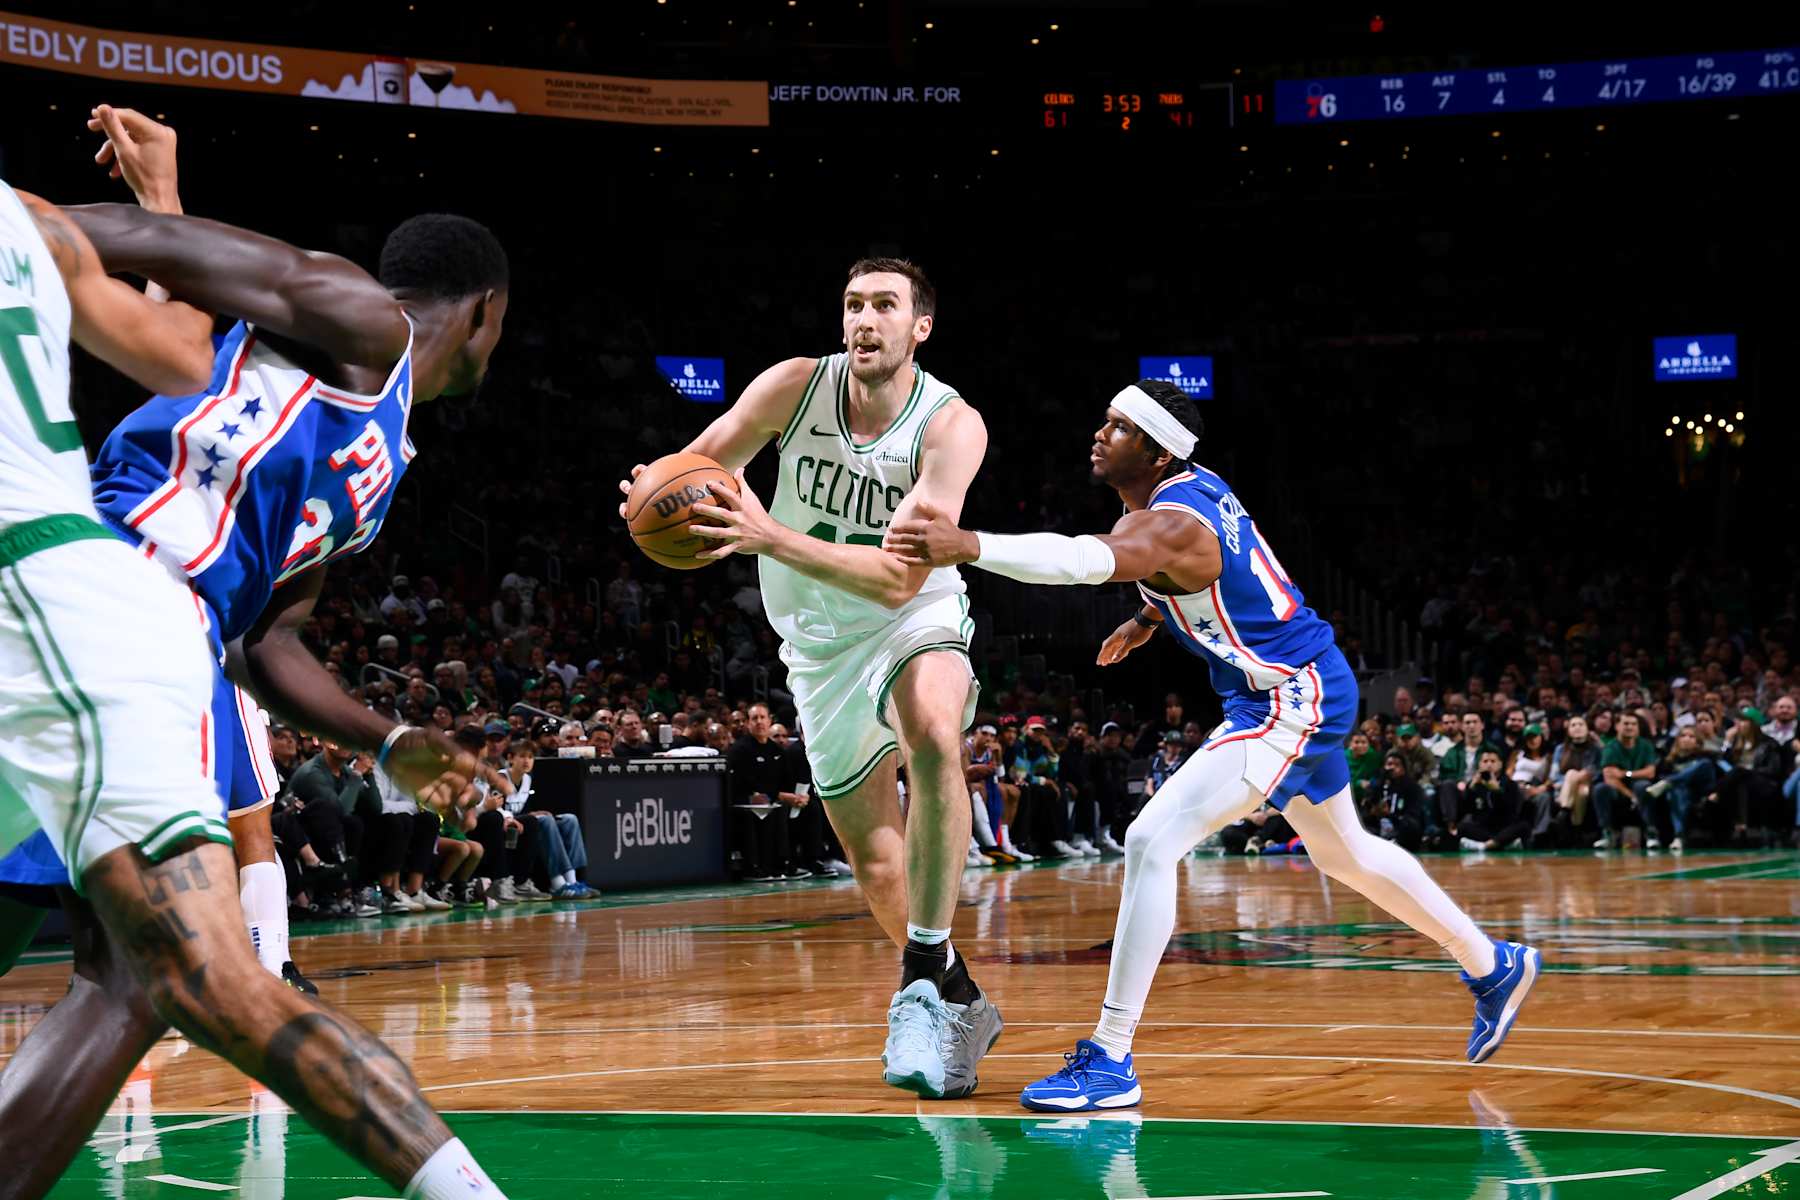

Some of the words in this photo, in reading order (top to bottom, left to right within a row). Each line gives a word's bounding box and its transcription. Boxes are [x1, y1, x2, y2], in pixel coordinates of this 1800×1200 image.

[98, 39, 283, 84] DELICIOUS
[1432, 75, 1455, 87] AST
[1487, 72, 1507, 83] STL
[1538, 69, 1556, 80] TO
[1679, 72, 1736, 94] 16/39
[1381, 79, 1404, 90] REB
[1599, 79, 1646, 99] 4/17
[770, 86, 811, 101] JEFF
[817, 86, 888, 102] DOWTIN
[893, 87, 919, 102] JR.
[924, 87, 961, 102] FOR
[1439, 91, 1451, 110] 7
[1492, 89, 1505, 105] 4
[1542, 86, 1555, 102] 4
[1104, 94, 1141, 113] 3:53
[1243, 95, 1263, 113] 11
[1384, 95, 1406, 112] 16
[1045, 111, 1067, 128] 61
[1121, 116, 1131, 130] 2
[671, 378, 720, 389] BELLA
[875, 451, 909, 464] Amica
[652, 481, 726, 518] Wils
[796, 455, 904, 529] CELTICS
[614, 797, 692, 860] jetBlue
